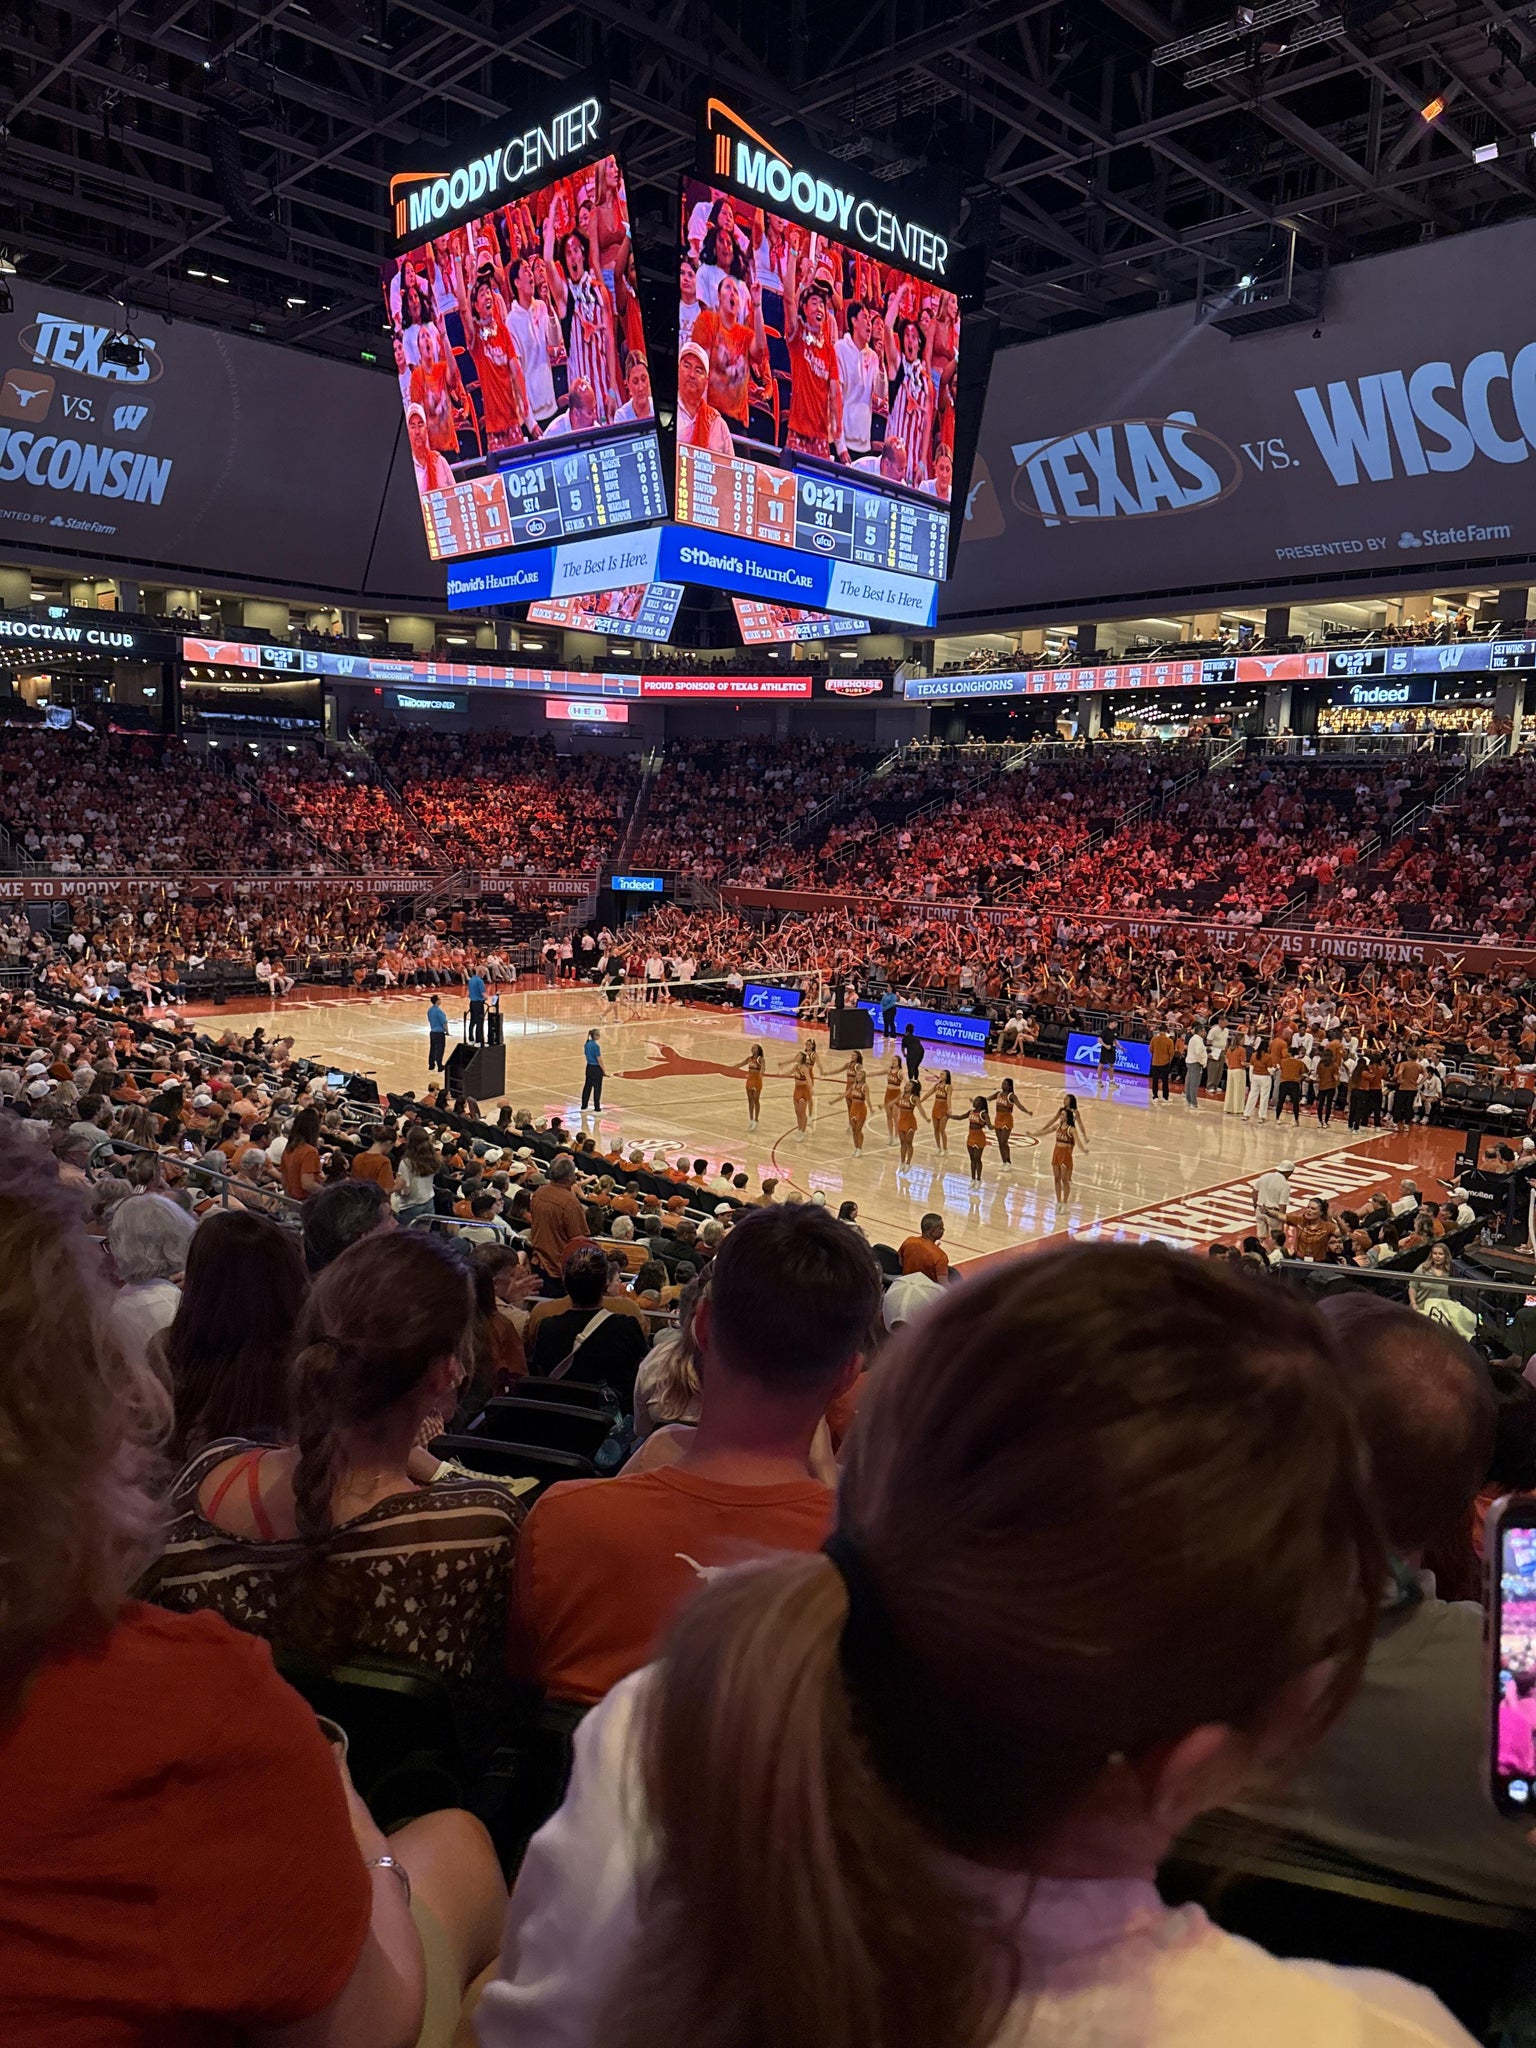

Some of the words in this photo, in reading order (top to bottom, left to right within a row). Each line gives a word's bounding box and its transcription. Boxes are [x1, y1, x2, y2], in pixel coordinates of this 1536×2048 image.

[410, 149, 501, 231] MOODY
[503, 98, 600, 182] CENTER
[736, 143, 855, 228] MOODY
[856, 202, 948, 275] CENTER
[61, 395, 95, 422] VS.
[1011, 411, 1222, 527] TEXAS
[1241, 440, 1300, 473] VS.
[508, 466, 546, 498] 0:21
[523, 498, 534, 513] SET
[534, 496, 541, 511] 4
[569, 489, 582, 511] 5
[802, 481, 844, 513] 0:21
[33, 514, 46, 524] BY
[485, 506, 501, 528] 11
[768, 500, 784, 523] 11
[815, 511, 827, 526] SET
[827, 514, 833, 528] 4
[784, 532, 790, 542] 2
[816, 535, 832, 547] ufcu
[864, 525, 876, 546] 5
[1276, 539, 1364, 560] PRESENTED
[1368, 536, 1387, 551] BY
[563, 562, 582, 578] The
[584, 558, 607, 574] Best
[608, 556, 617, 570] Is
[620, 552, 648, 568] Here.
[840, 579, 860, 596] The
[862, 583, 885, 601] Best
[886, 588, 896, 603] Is
[898, 591, 923, 610] Here.
[662, 602, 674, 611] 44
[623, 624, 631, 633] 5
[636, 625, 655, 635] BLOCKS
[655, 627, 666, 637] 6.0
[822, 625, 831, 634] 5
[834, 621, 852, 631] BLOCKS
[853, 620, 865, 629] 6.0
[86, 629, 134, 648] CLUB
[240, 647, 257, 662] 11
[264, 649, 293, 663] 0:21
[1494, 644, 1505, 654] SET
[1505, 643, 1526, 654] WINS:
[305, 654, 318, 669] 5
[1229, 659, 1235, 669] 2
[1305, 657, 1324, 674] 11
[1335, 652, 1372, 668] 0:21
[1392, 652, 1407, 670] 5
[1493, 657, 1508, 667] TOL:
[1514, 656, 1520, 667] 1
[1154, 665, 1168, 675] ACES
[1182, 664, 1194, 673] ERR
[1217, 671, 1223, 681] 2
[1347, 667, 1357, 675] SET
[1357, 666, 1362, 674] 4
[644, 681, 674, 690] PROUD
[675, 682, 715, 690] SPONSOR
[717, 682, 729, 690] OF
[730, 682, 758, 691] TEXAS
[760, 682, 807, 691] ATHLETICS
[827, 680, 881, 689] FIREHOUSE
[918, 683, 948, 695] TEXAS
[950, 679, 1013, 693] LONGHORNS
[1055, 682, 1068, 691] 7.0
[1350, 685, 1409, 703] indeed
[404, 700, 431, 709] MOODY
[31, 882, 54, 896] TO
[366, 880, 434, 893] LONGHORNS
[480, 880, 516, 892] HOOK
[548, 882, 590, 894] HORNS
[618, 877, 654, 890] indeed
[1310, 937, 1425, 963] LONGHORNS
[937, 1026, 958, 1037] STAY
[957, 1029, 986, 1042] TUNED
